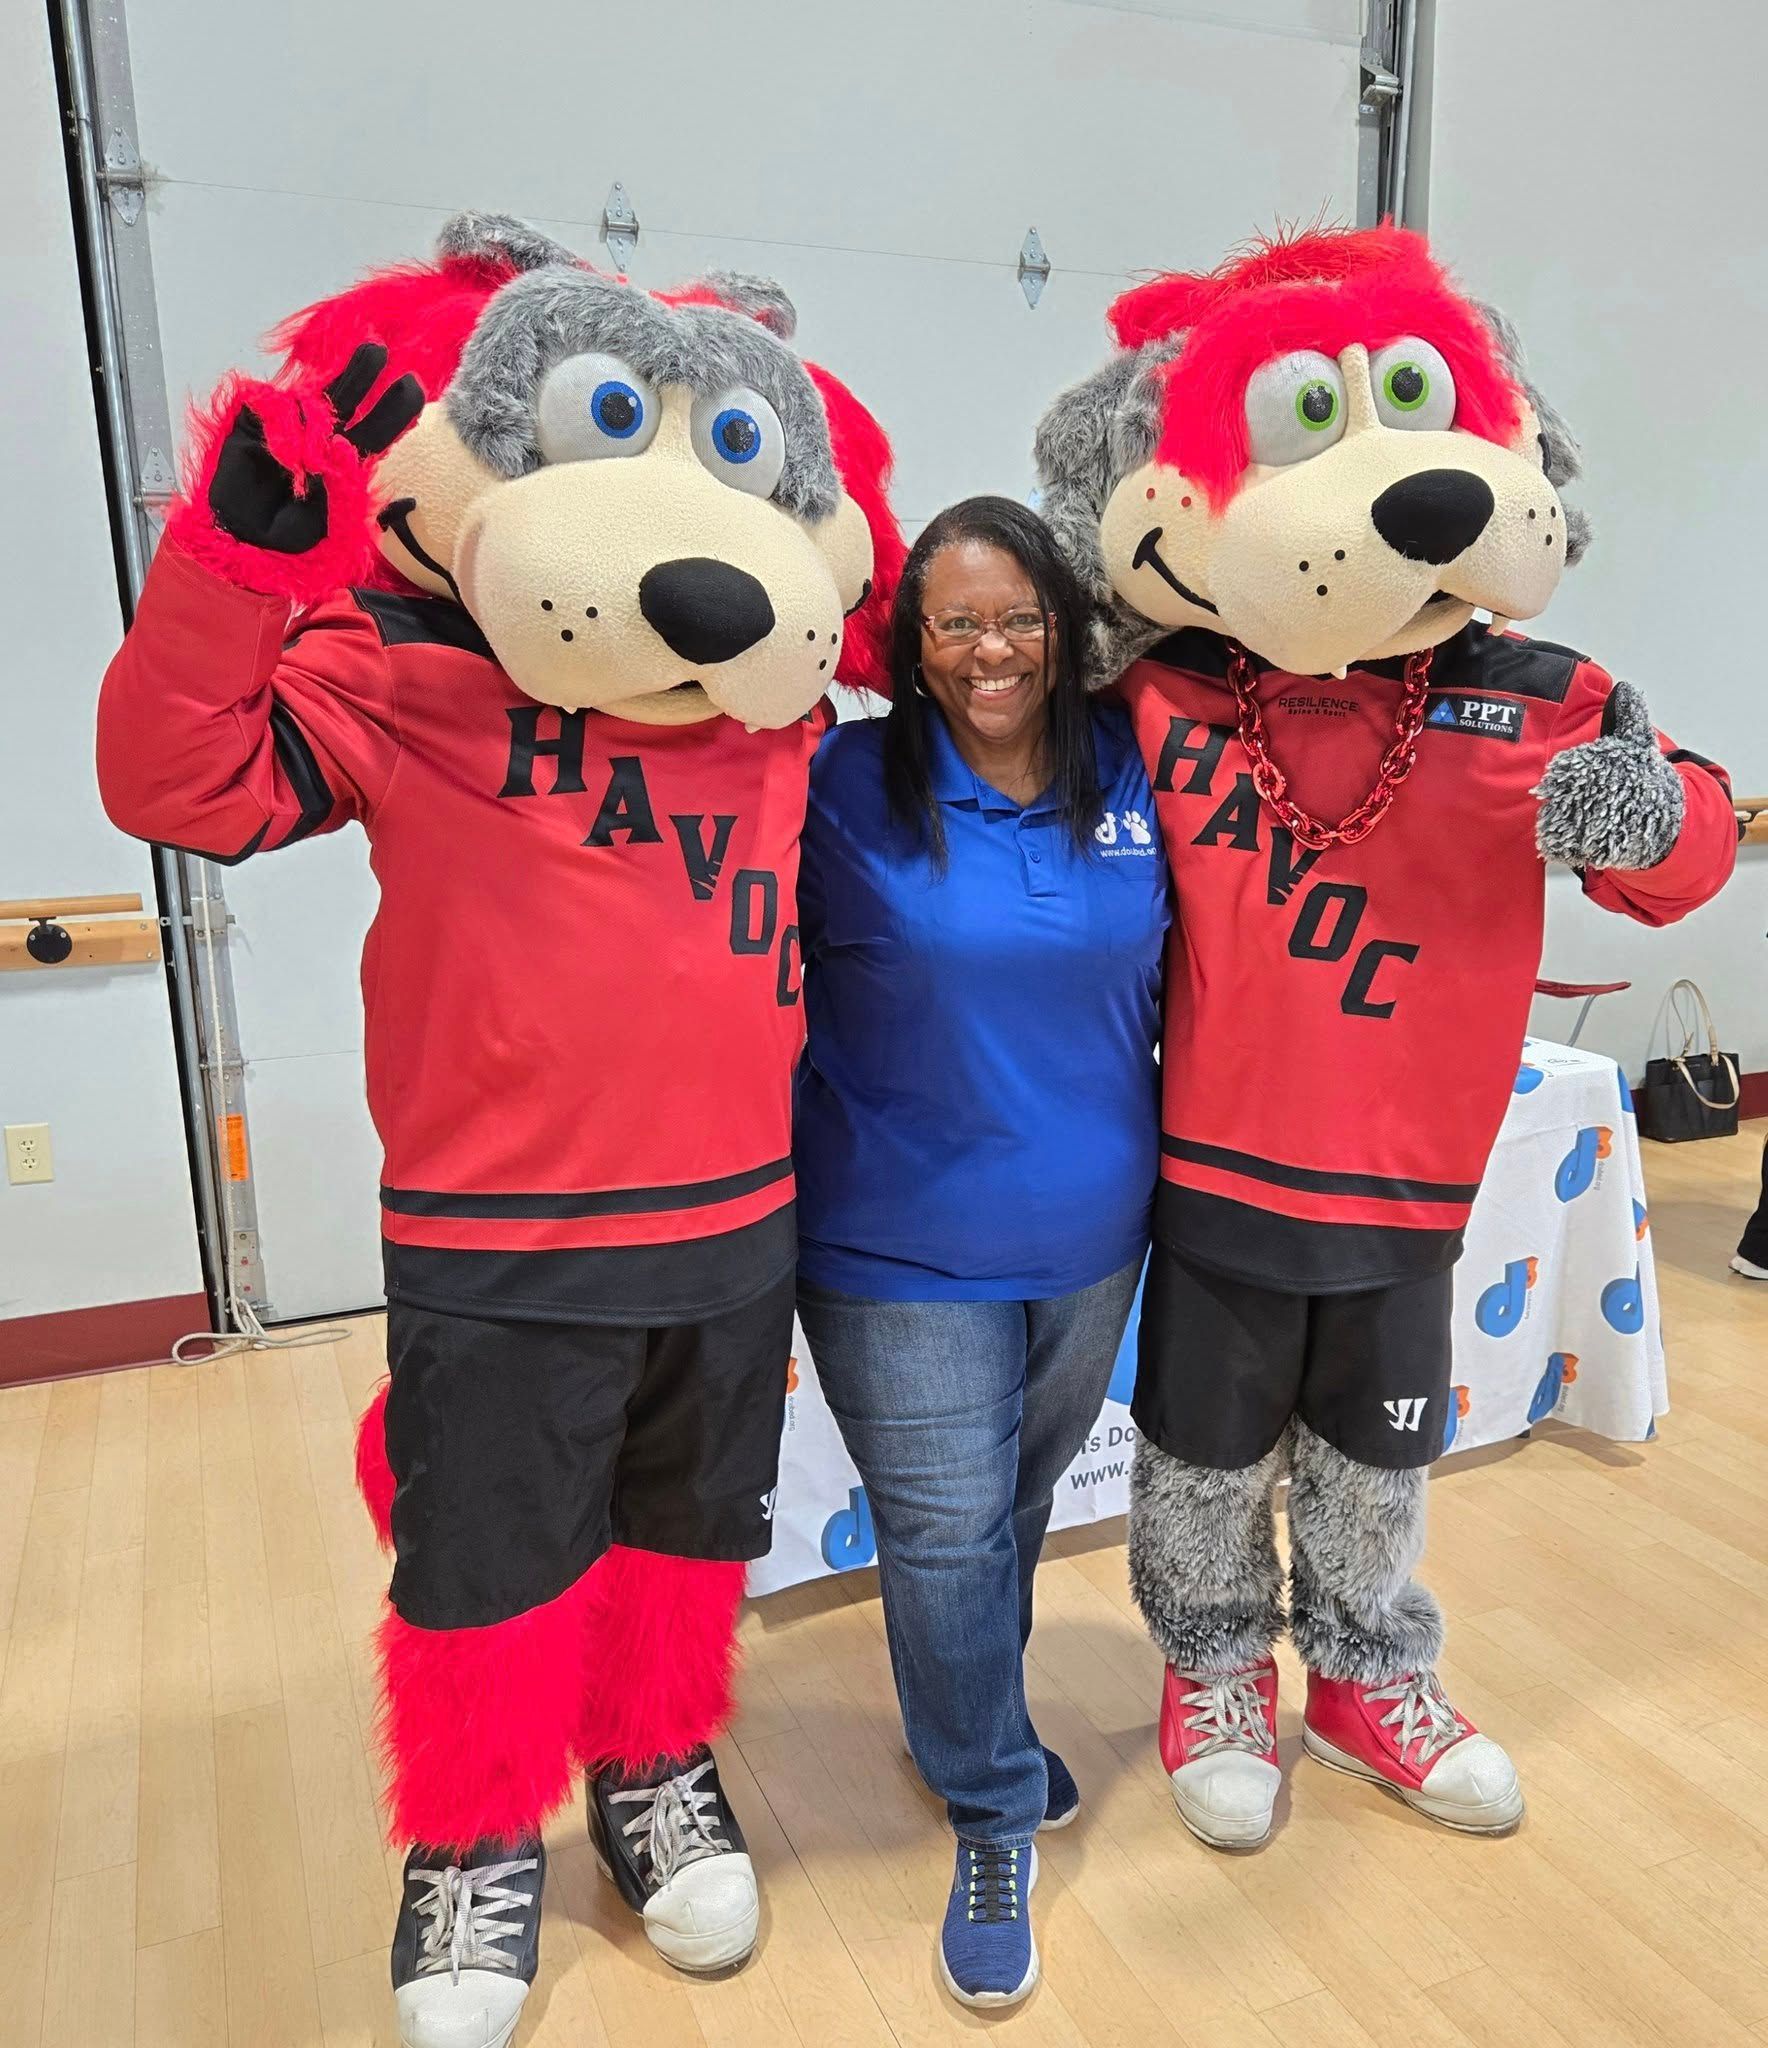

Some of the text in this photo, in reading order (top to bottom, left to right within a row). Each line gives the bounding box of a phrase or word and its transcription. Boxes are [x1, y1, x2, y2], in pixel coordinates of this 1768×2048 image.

[1279, 697, 1359, 712] RESILIENCE
[1461, 701, 1516, 724] PPT
[1460, 719, 1513, 733] SOLUTIONS
[496, 706, 800, 1007] HAVOC
[1153, 715, 1420, 1019] HAVOC
